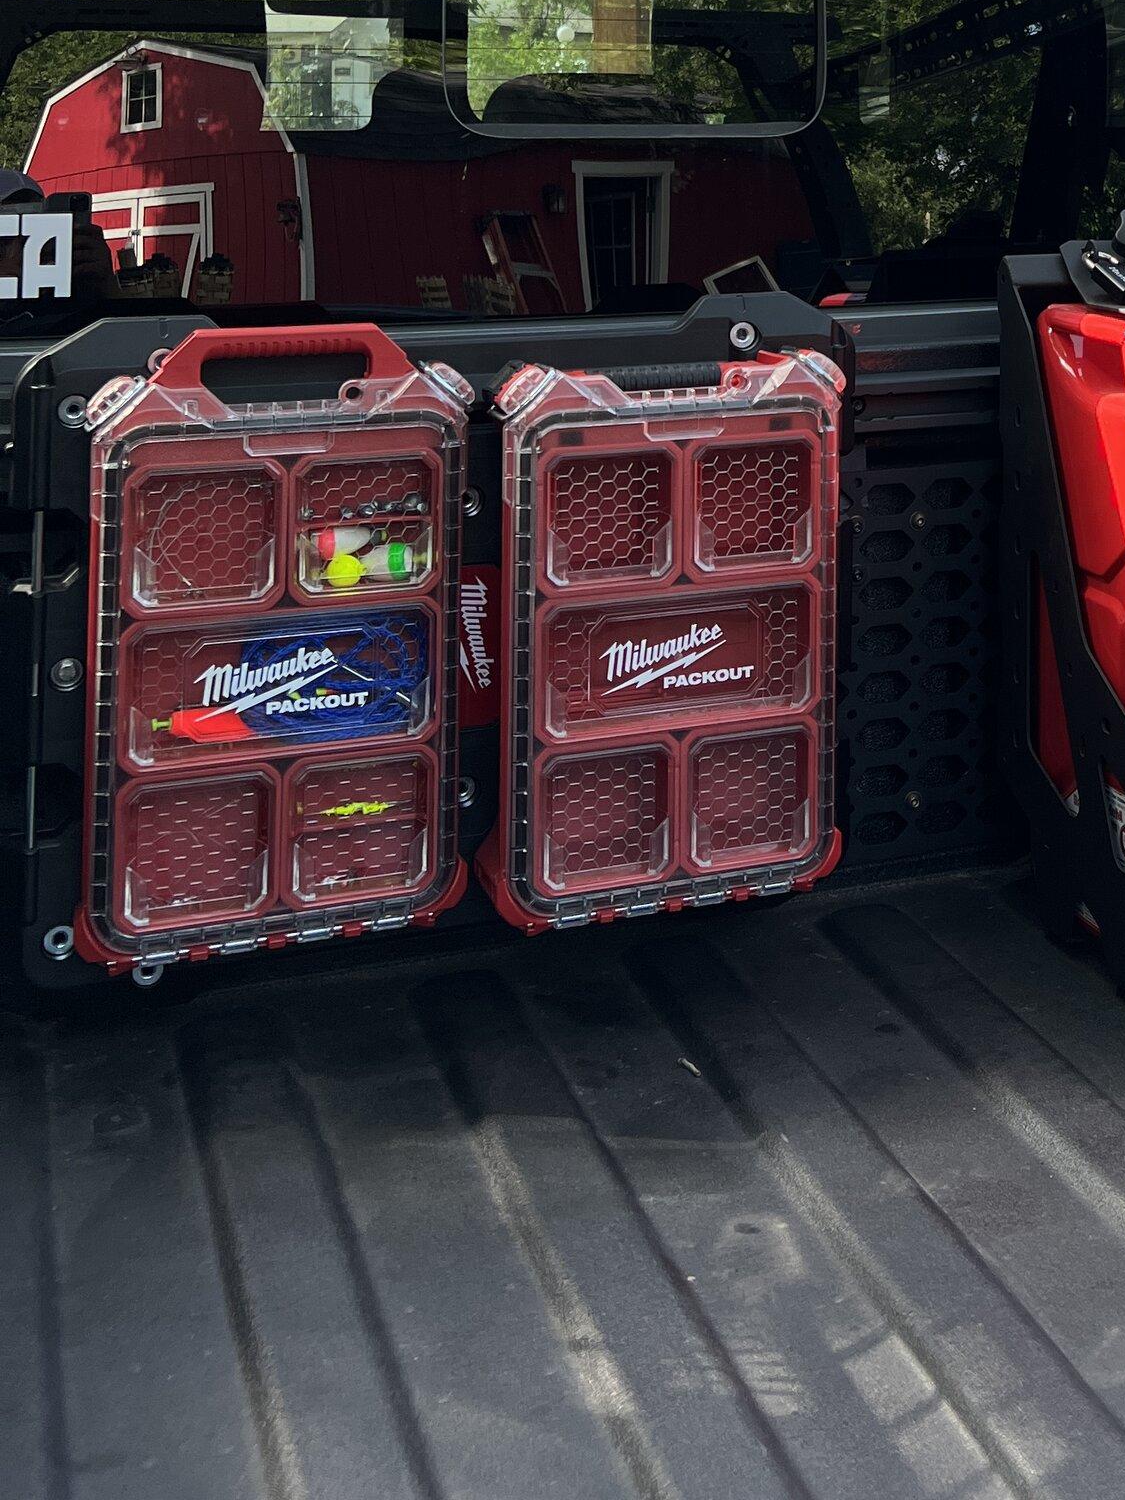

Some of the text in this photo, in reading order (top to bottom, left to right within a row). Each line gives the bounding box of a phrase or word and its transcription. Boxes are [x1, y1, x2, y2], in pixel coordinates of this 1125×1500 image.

[461, 575, 495, 689] Milwaukee
[599, 624, 723, 682] Milwaukee
[194, 648, 335, 706] Milwaukee
[266, 692, 368, 715] PACKOUT
[654, 665, 755, 689] PACKOUT
